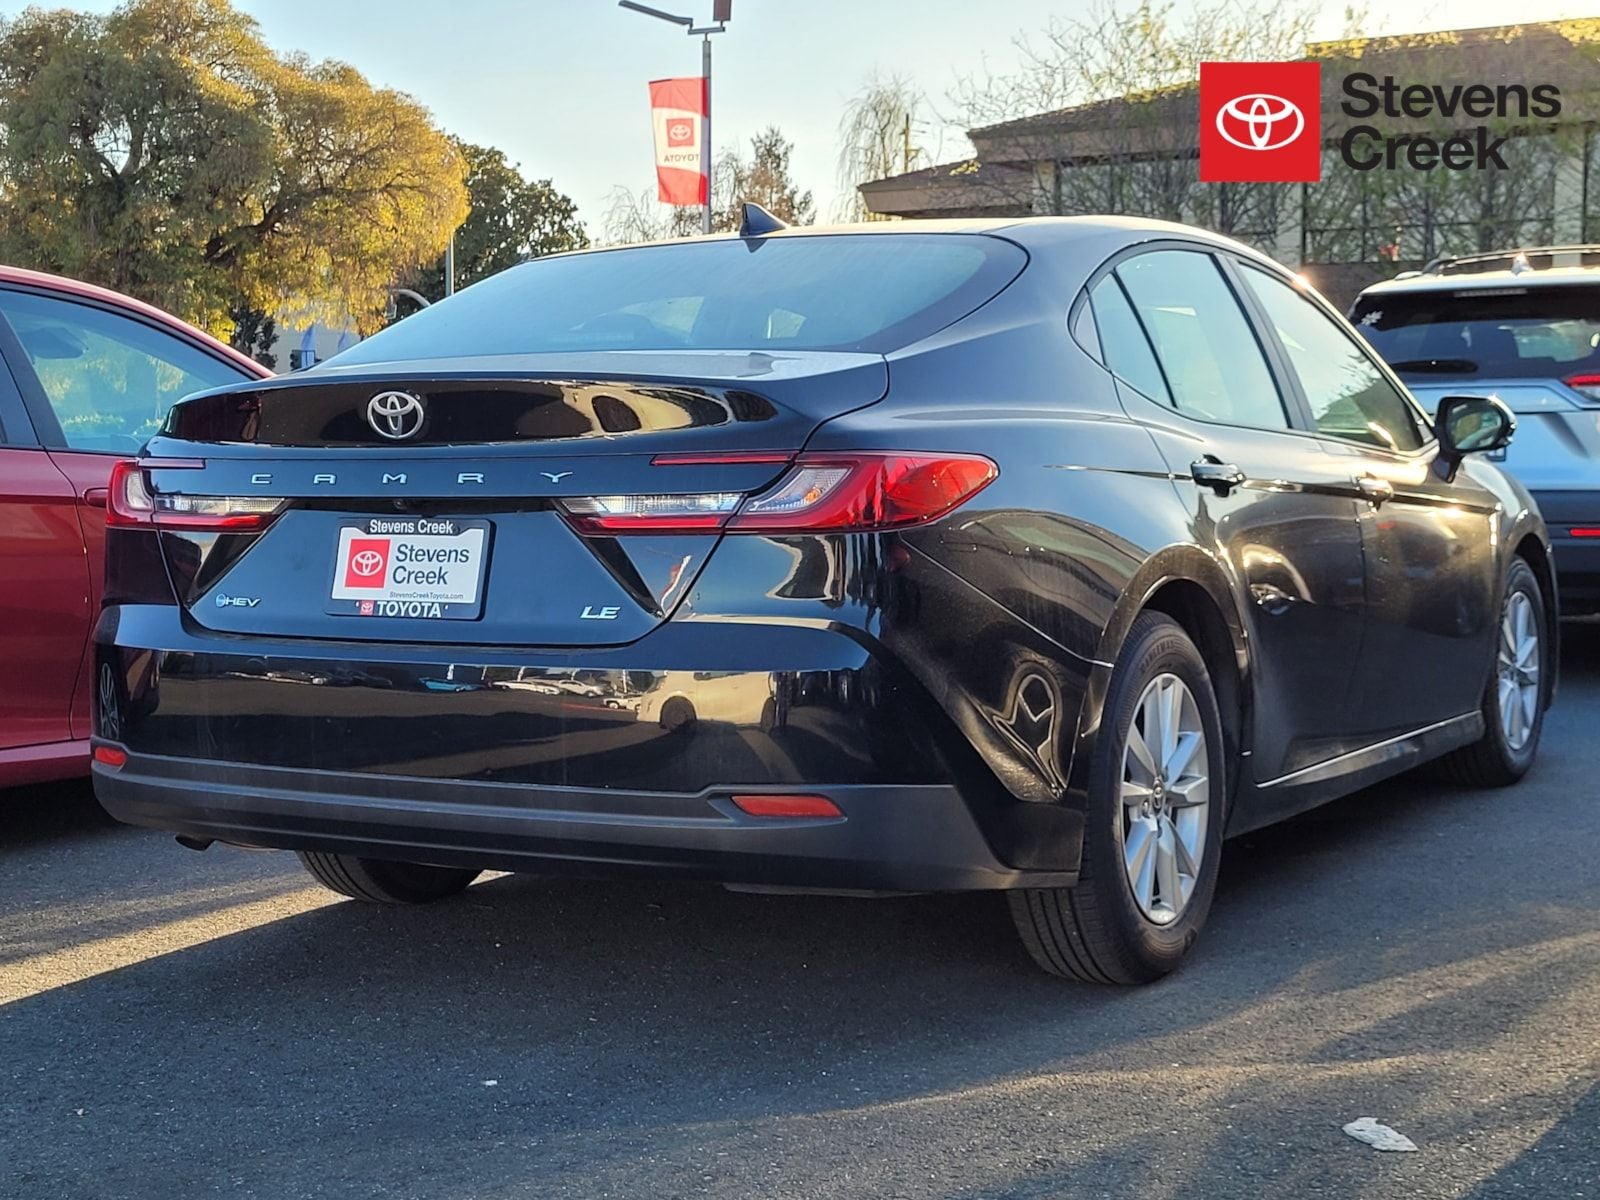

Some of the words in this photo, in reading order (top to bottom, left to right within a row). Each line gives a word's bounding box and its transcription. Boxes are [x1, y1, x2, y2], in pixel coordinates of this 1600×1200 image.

[251, 472, 573, 484] CAMRY
[369, 519, 415, 534] Stevens
[417, 519, 454, 534] Creek
[395, 544, 470, 563] Stevens
[392, 566, 449, 585] Creek
[389, 591, 464, 600] StevensCreekToyota.com
[377, 602, 442, 618] TOYOTA
[580, 606, 621, 619] LE
